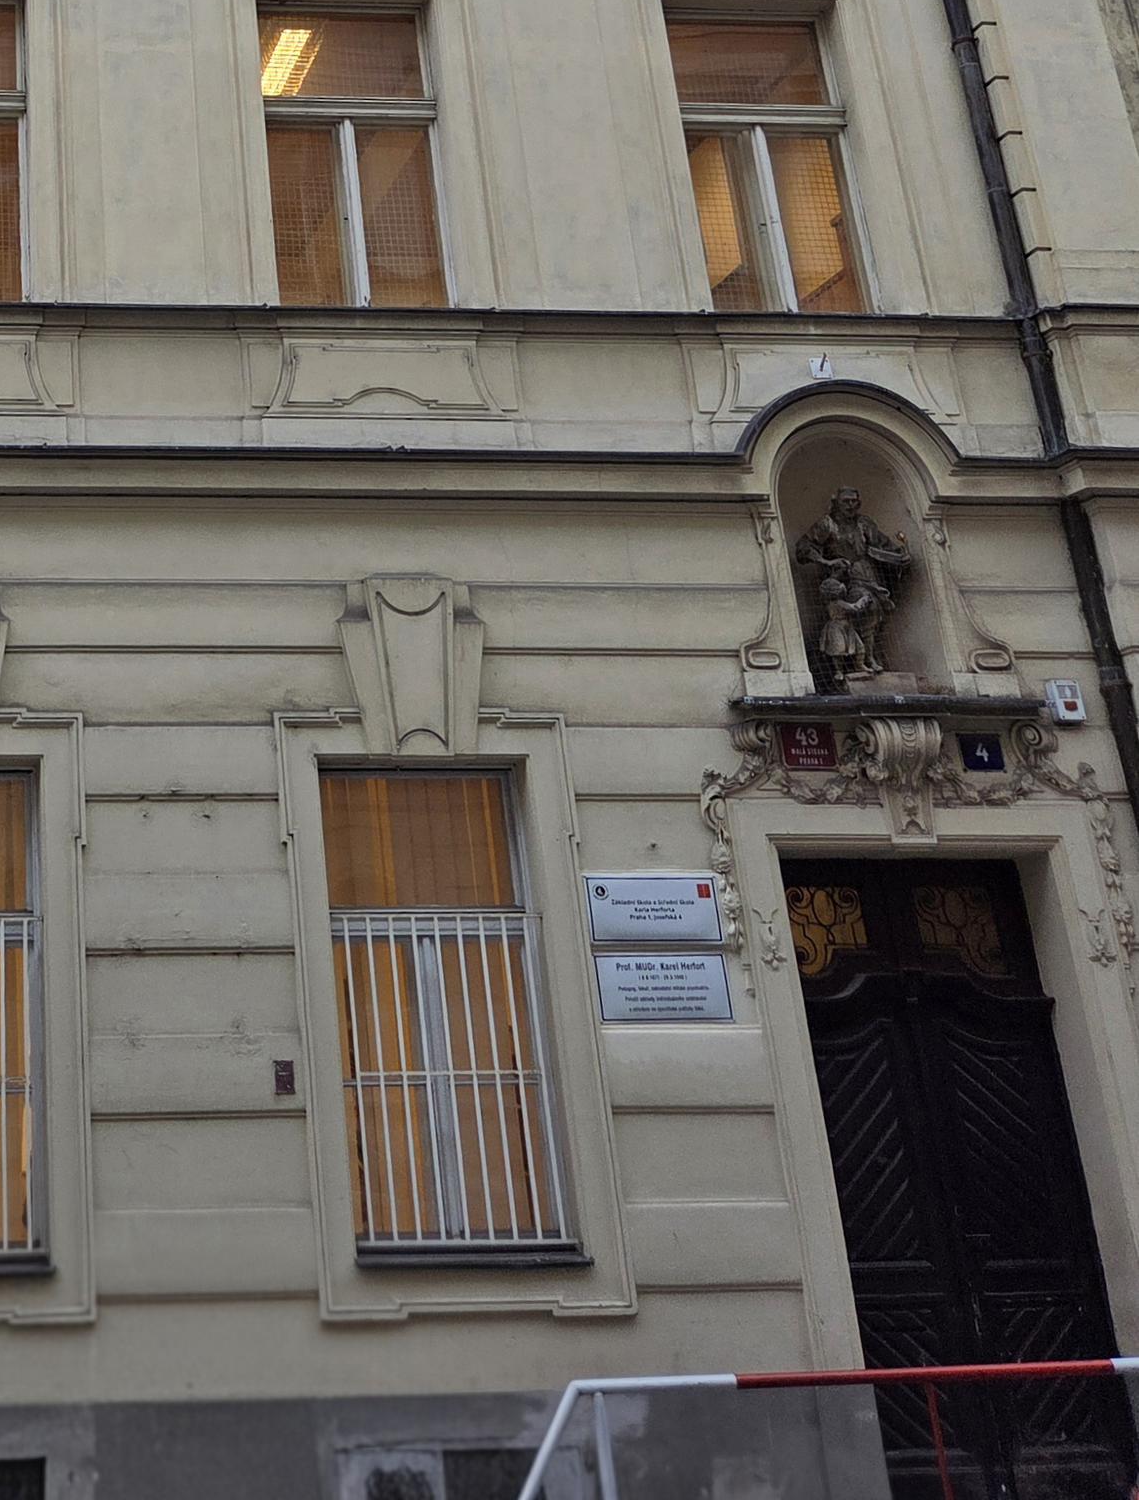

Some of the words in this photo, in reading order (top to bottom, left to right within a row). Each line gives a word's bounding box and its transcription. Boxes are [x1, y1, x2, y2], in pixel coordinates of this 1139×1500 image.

[795, 727, 819, 746] 43
[975, 743, 989, 762] 4
[616, 962, 633, 971] Prof.
[635, 962, 658, 971] MUDr.
[660, 962, 679, 971] Karel
[680, 962, 705, 970] Herfort
